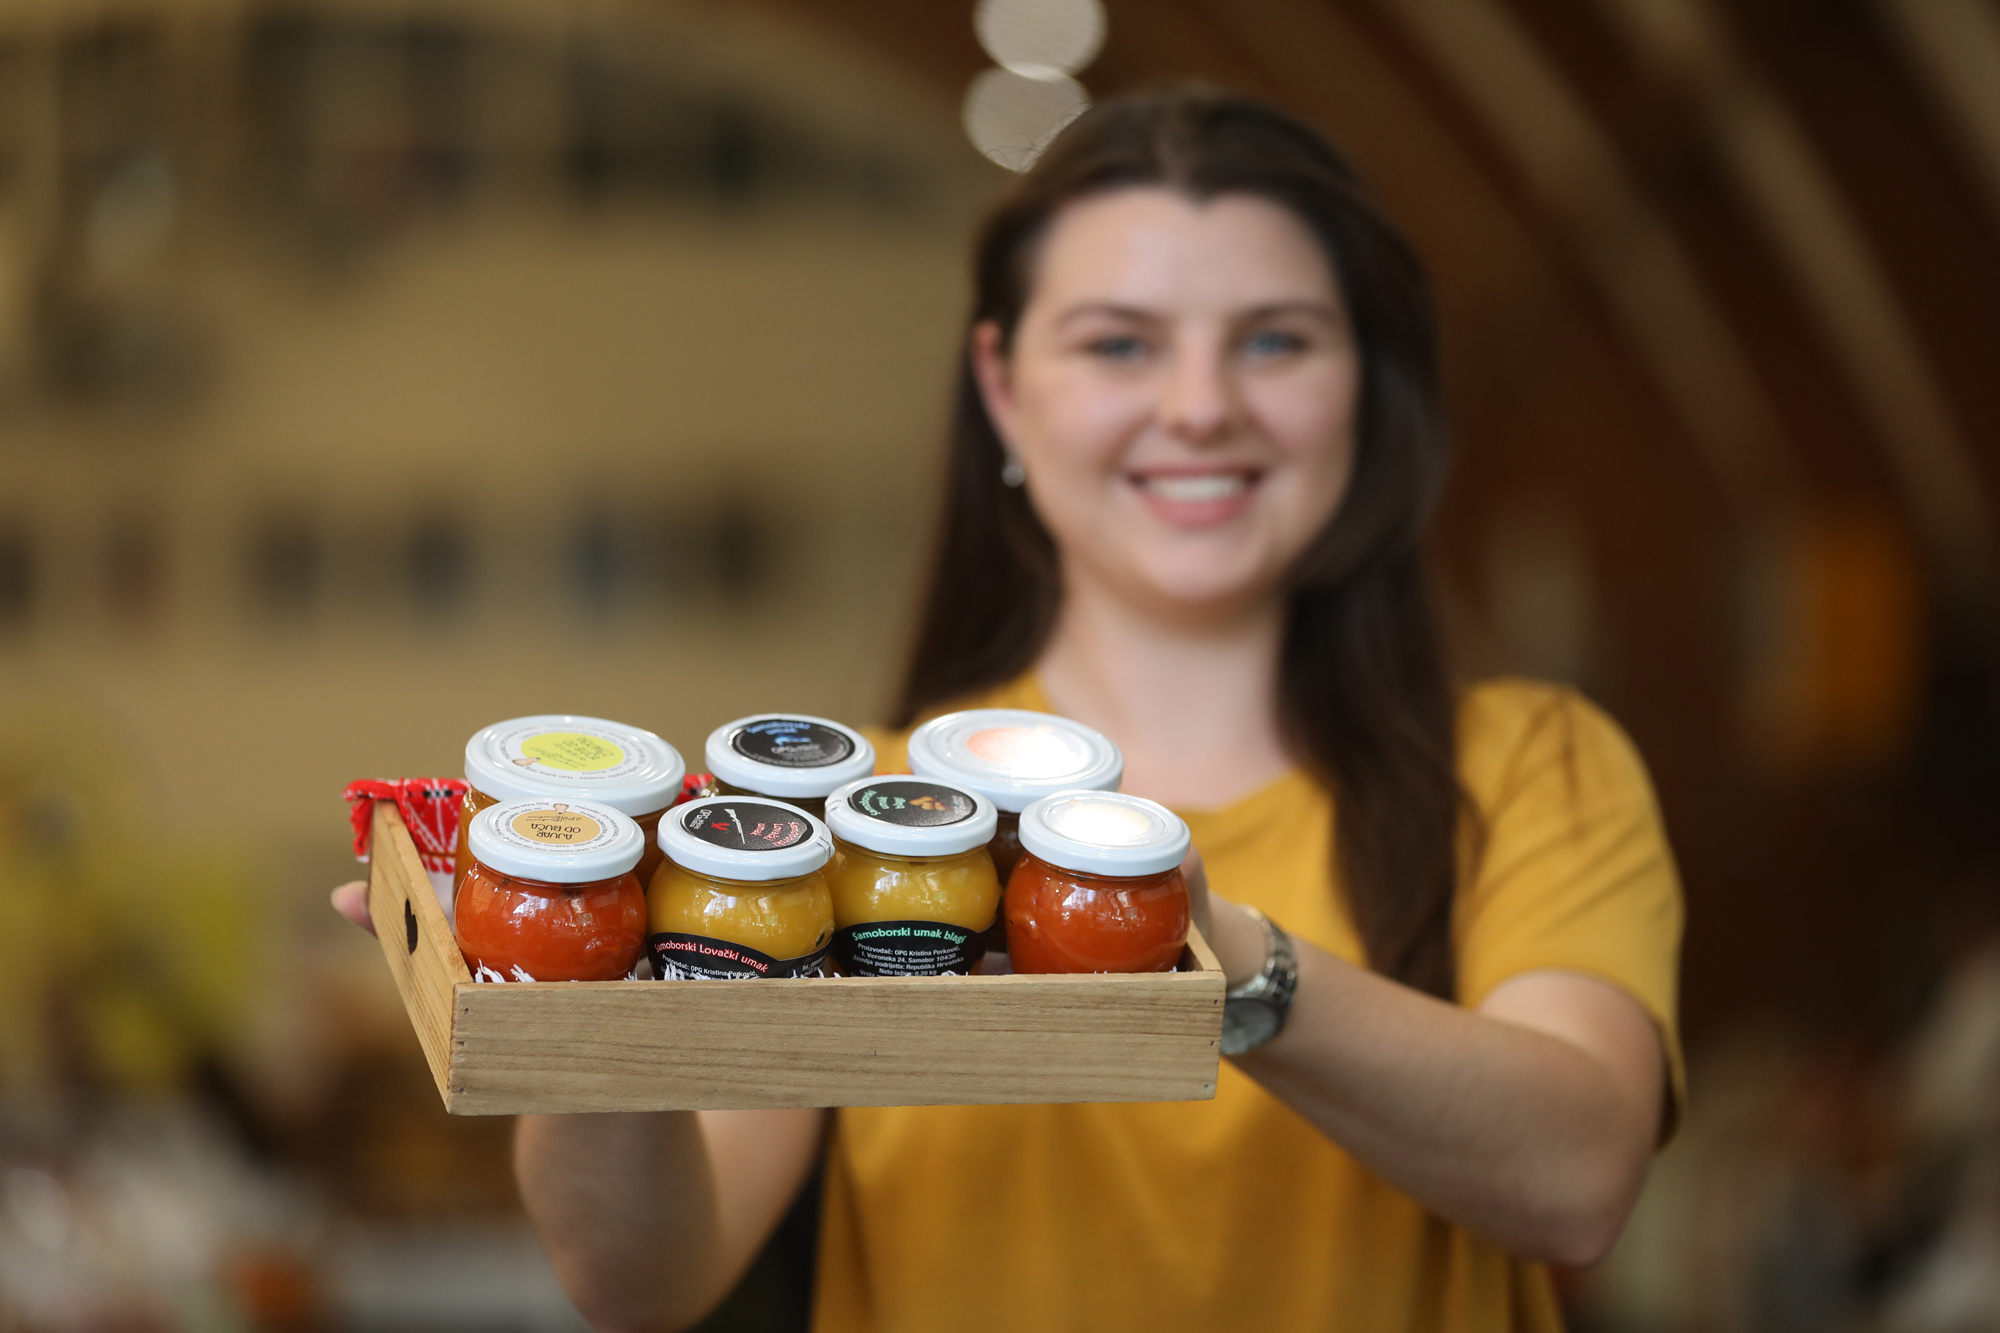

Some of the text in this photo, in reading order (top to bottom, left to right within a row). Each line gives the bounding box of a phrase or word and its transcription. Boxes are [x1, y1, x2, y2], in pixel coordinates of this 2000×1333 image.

[852, 927, 967, 944] Samoborski umak blagi
[699, 943, 740, 961] Lovački
[740, 955, 769, 973] umak
[853, 954, 874, 966] Zemlja
[937, 956, 964, 969] Hrvatska
[867, 953, 896, 963] Veroneka
[936, 953, 957, 962] 10430
[690, 965, 703, 973] OPG
[703, 968, 727, 976] Kristina
